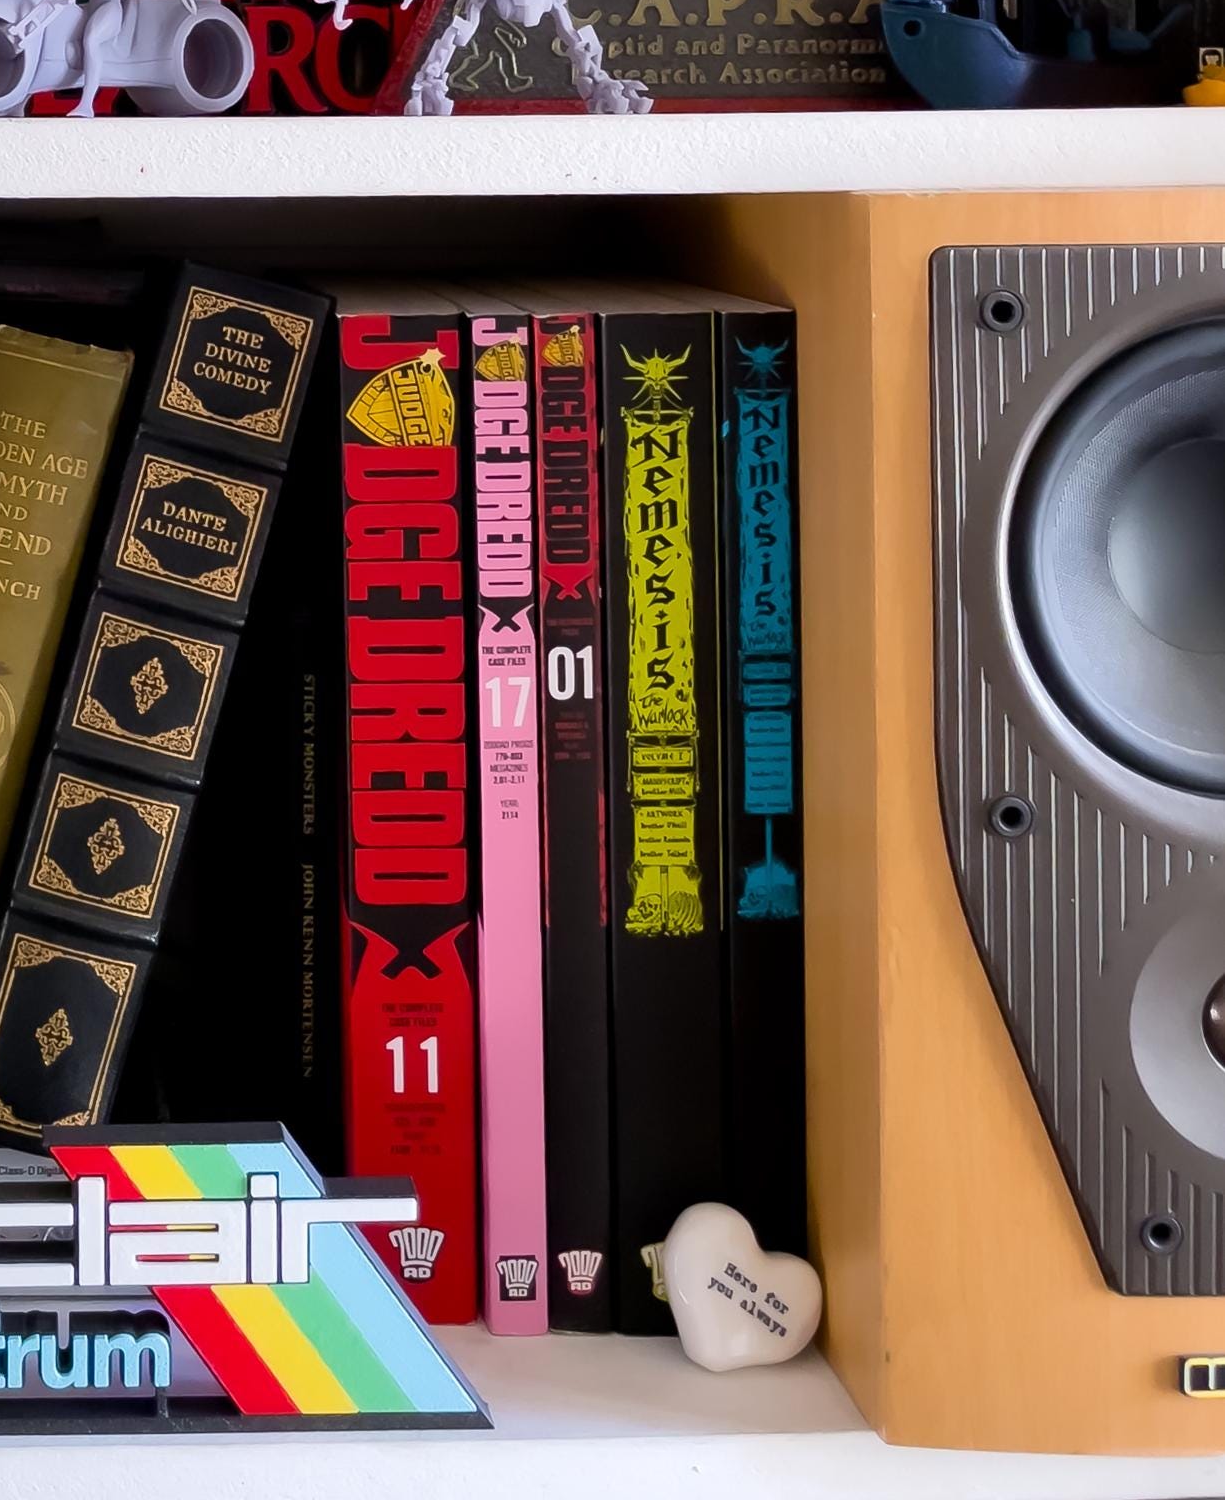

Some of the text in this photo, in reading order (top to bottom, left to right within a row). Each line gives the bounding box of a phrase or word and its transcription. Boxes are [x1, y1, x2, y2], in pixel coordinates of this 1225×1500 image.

[676, 34, 725, 56] and
[719, 62, 887, 85] Association
[222, 325, 265, 350] THE
[204, 342, 273, 375] DIVINE
[193, 361, 273, 397] COMEDY
[0, 411, 46, 440] THE
[41, 452, 89, 480] AGE
[162, 500, 227, 533] DANTE
[141, 517, 239, 557] ALIGHIERI
[633, 425, 685, 690] Nemesis
[548, 645, 594, 701] 01
[485, 676, 531, 728] 17
[638, 706, 689, 729] Warlock
[301, 673, 316, 1079] STICKY MONSTERS JOHN KENN MORTENSEN
[386, 1036, 439, 1094] 11
[724, 1262, 789, 1314] Here for
[707, 1276, 788, 1338] you always
